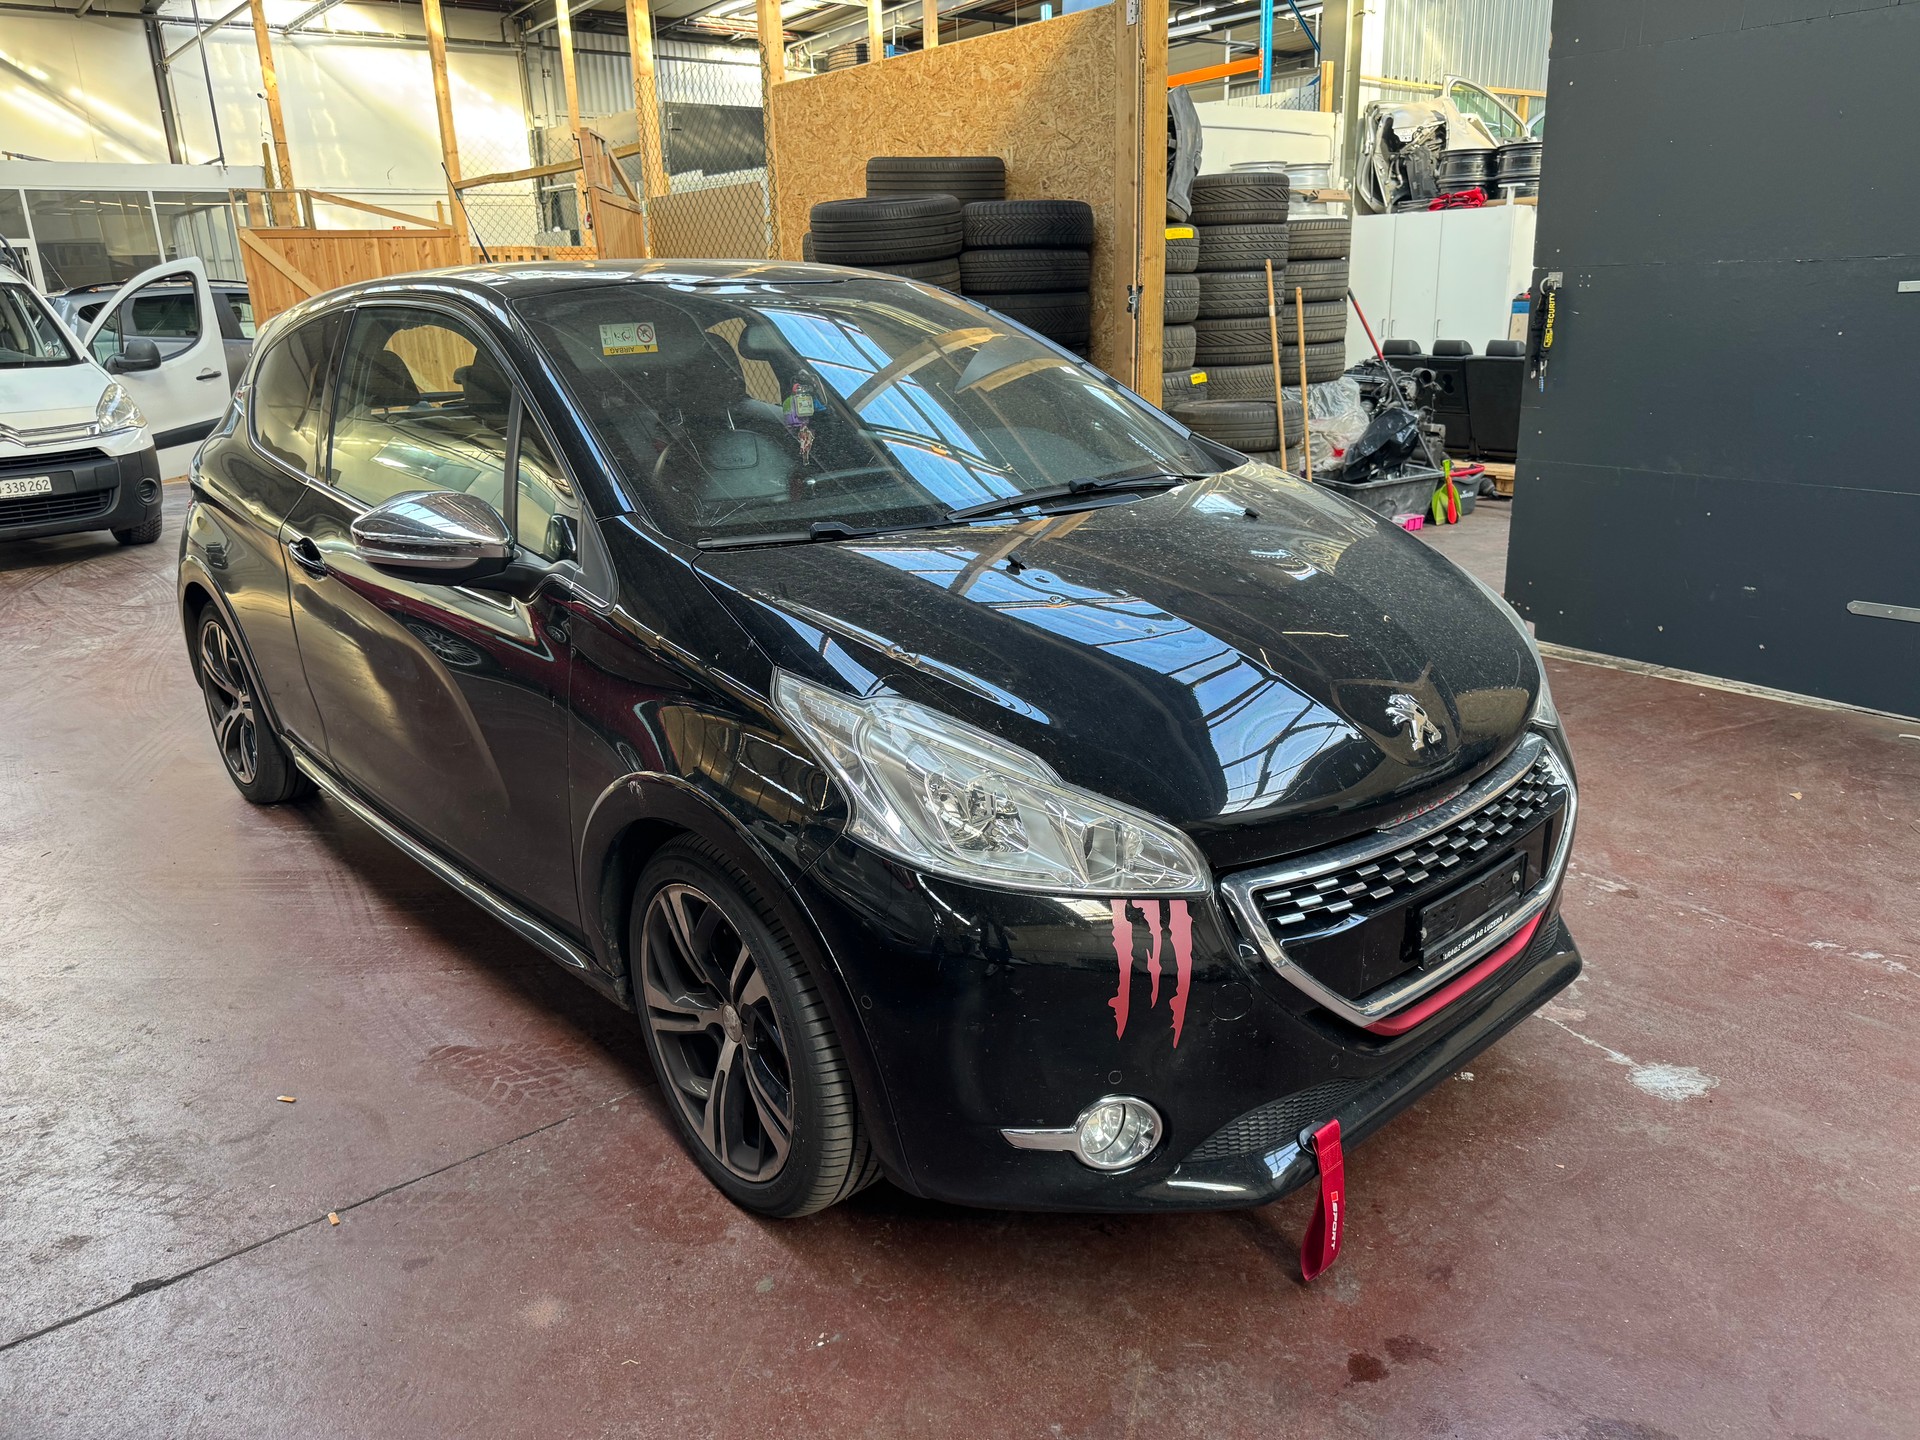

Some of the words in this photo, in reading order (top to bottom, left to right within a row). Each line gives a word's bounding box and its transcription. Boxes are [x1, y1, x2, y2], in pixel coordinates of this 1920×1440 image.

[1547, 292, 1555, 328] SECURITY
[609, 346, 635, 354] AIRBAG
[28, 480, 50, 491] 262
[1484, 914, 1504, 934] LUZERN
